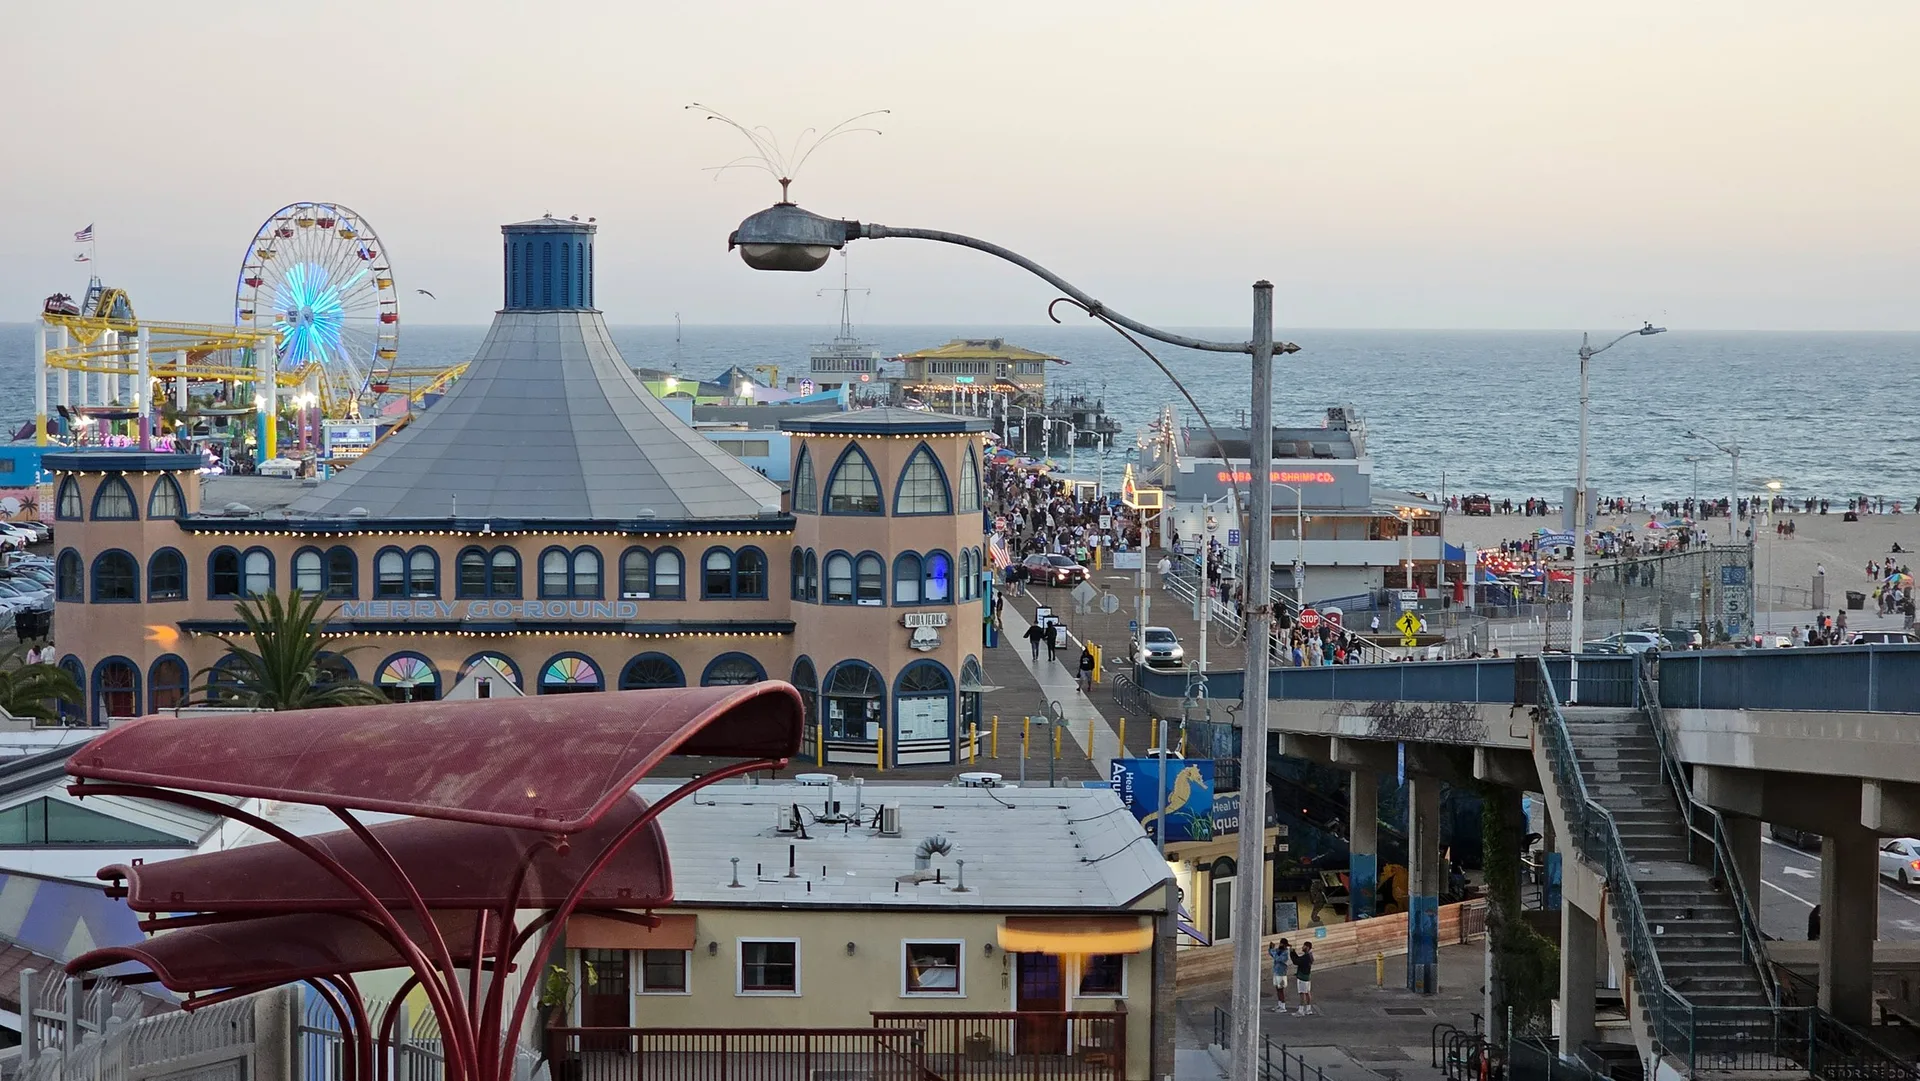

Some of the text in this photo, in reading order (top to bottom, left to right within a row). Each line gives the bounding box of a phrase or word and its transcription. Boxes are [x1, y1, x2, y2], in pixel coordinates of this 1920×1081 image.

[1280, 471, 1316, 482] SHRIMP
[341, 600, 639, 619] MERRY GO-ROUND
[1729, 600, 1739, 612] 5
[908, 614, 944, 626] SODA JERKS
[1301, 615, 1319, 624] STOP
[1125, 772, 1134, 793] Heal
[1212, 799, 1240, 813] Heal th
